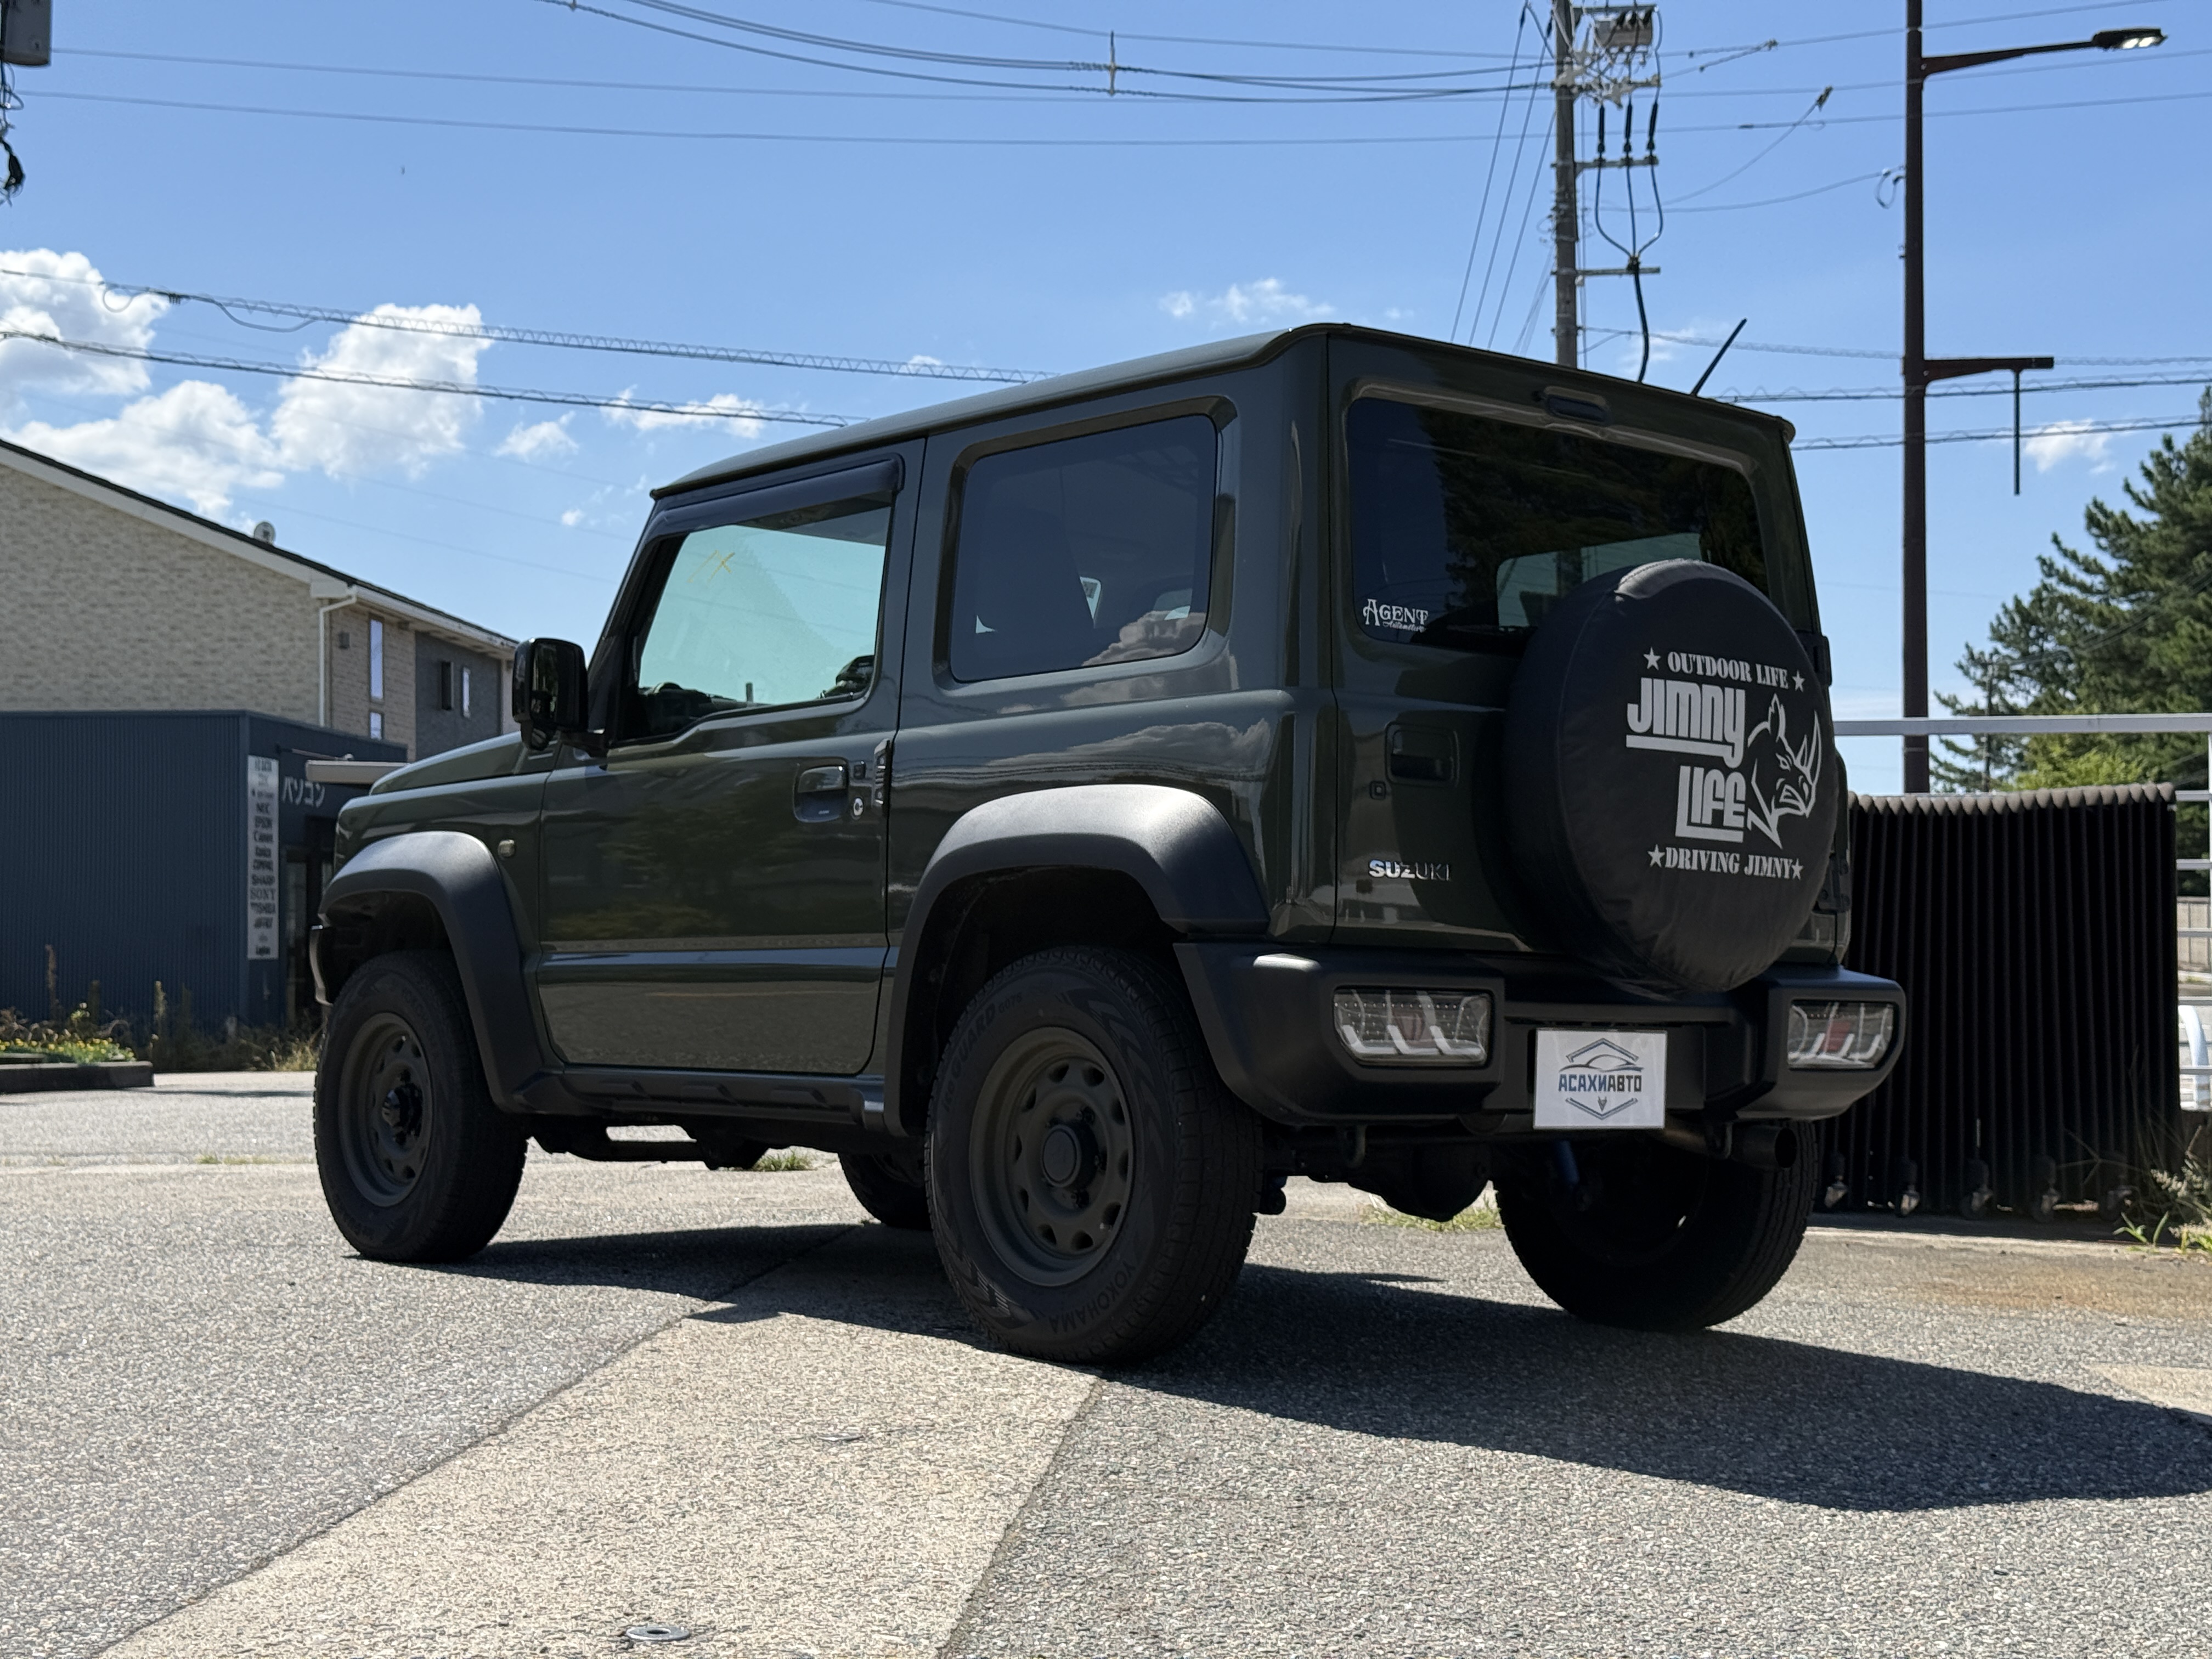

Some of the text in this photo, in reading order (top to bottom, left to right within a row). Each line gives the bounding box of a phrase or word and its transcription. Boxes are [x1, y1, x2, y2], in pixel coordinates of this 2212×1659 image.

[1363, 599, 1429, 627] AGENT
[1667, 651, 1788, 690] OUTDOOR LIFE
[1675, 765, 1746, 843] LIFE
[1369, 859, 1450, 881] SUZUKI
[1664, 847, 1793, 879] DRIVING JIMNY
[1558, 1074, 1642, 1092] АСАХИАВТО
[1048, 1260, 1136, 1334] YOKOHAMA
